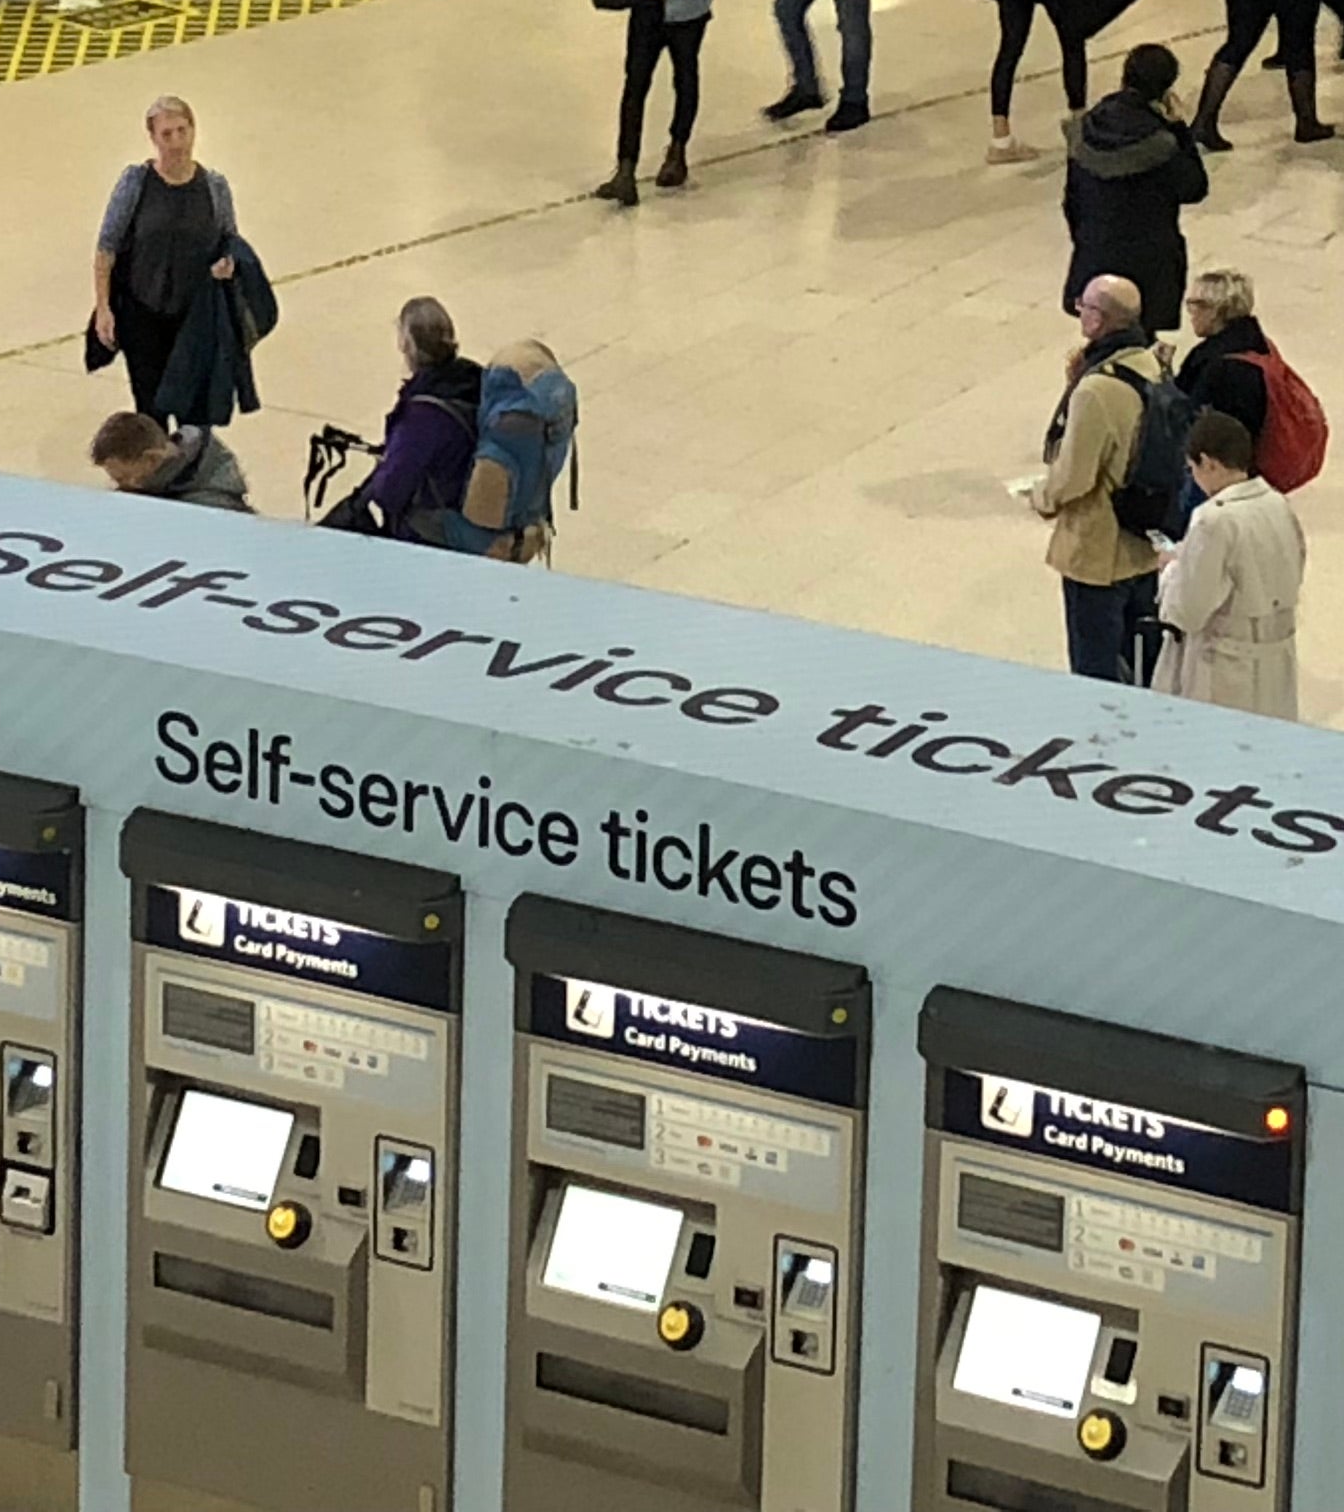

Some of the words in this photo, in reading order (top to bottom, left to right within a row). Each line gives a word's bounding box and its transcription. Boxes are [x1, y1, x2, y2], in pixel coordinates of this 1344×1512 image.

[155, 710, 581, 867] Self-service
[600, 810, 858, 928] tickets
[237, 904, 341, 944] TICKETS
[234, 935, 273, 958] Card
[276, 944, 357, 977] Payments
[627, 996, 739, 1037] TICKETS
[625, 1026, 666, 1050] Card
[669, 1036, 756, 1071] Payments
[1046, 1091, 1165, 1137] TICKETS
[1044, 1125, 1088, 1150] Card
[1092, 1136, 1184, 1173] Payments
